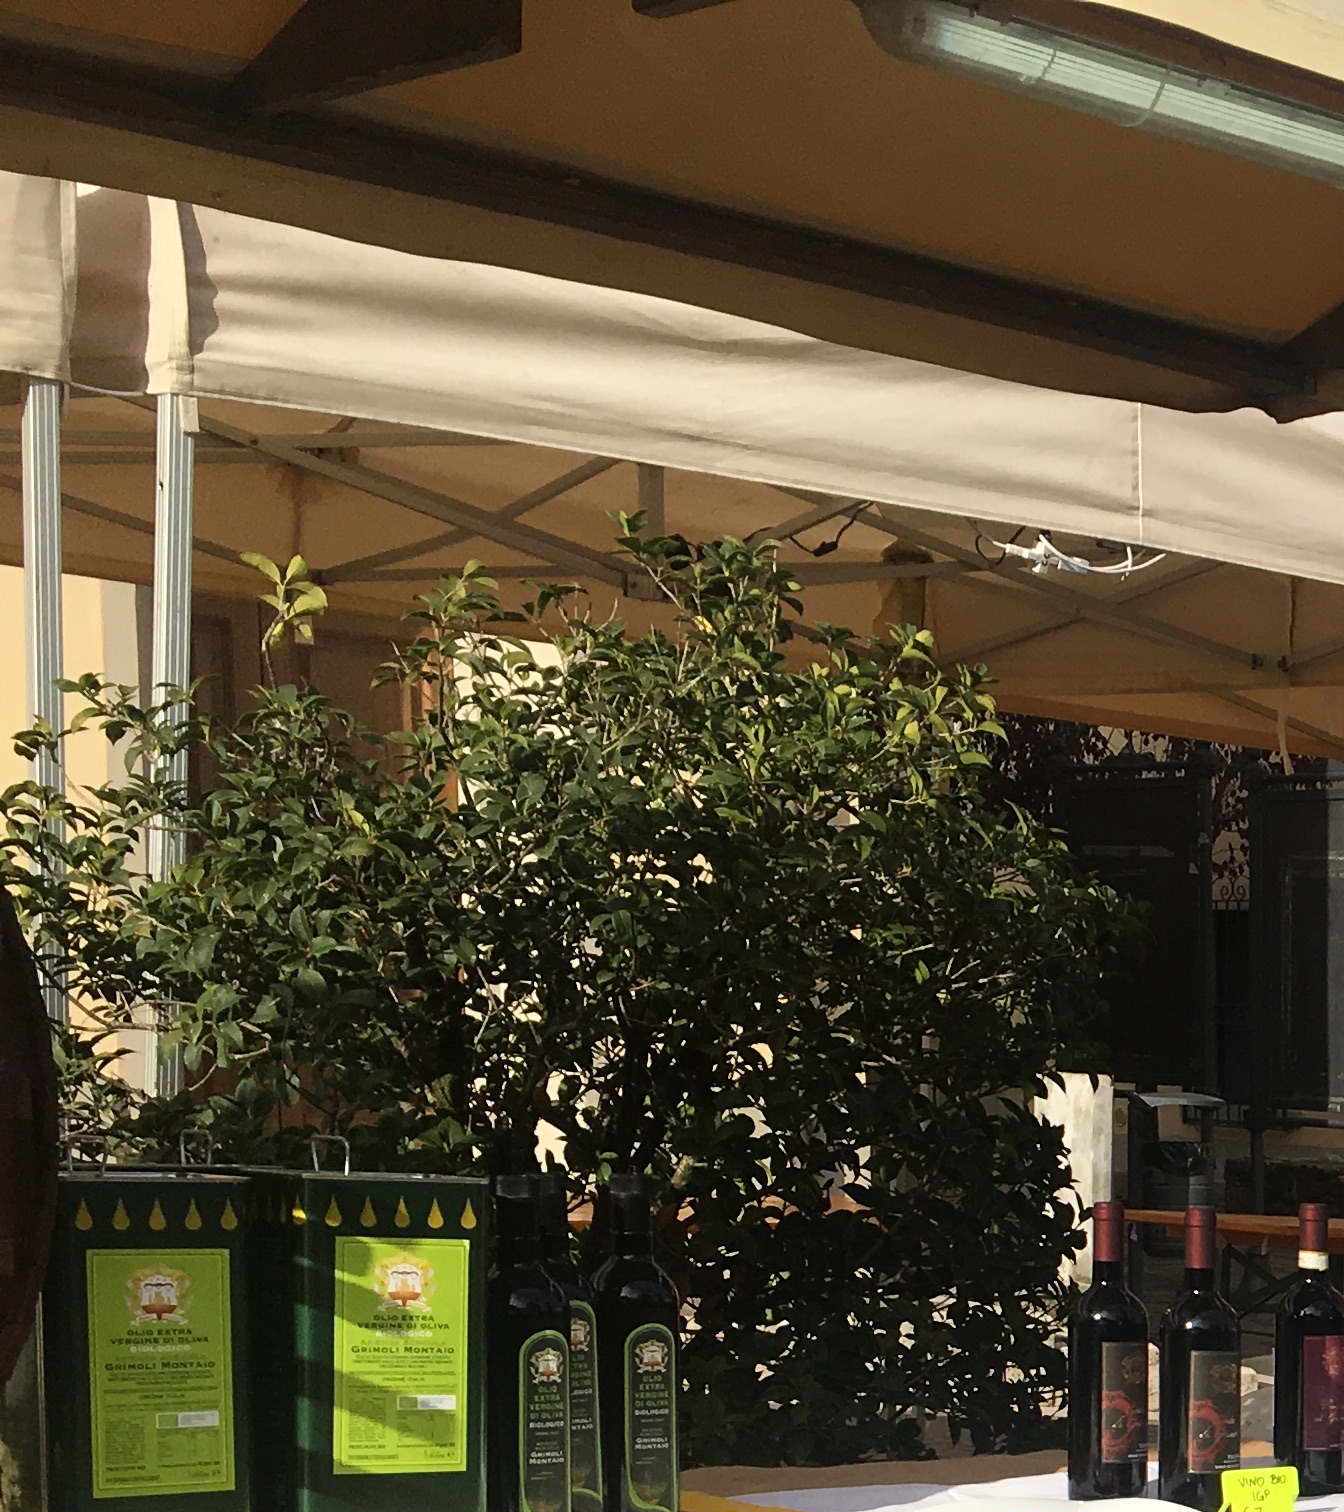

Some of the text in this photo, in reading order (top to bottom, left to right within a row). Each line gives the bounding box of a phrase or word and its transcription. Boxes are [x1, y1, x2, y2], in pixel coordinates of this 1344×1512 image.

[401, 1313, 435, 1322] EXTRA
[357, 1322, 402, 1330] VERGINE
[420, 1322, 450, 1330] OLIVA
[127, 1327, 193, 1336] OLIO EXTRA
[110, 1336, 160, 1345] VERGINE
[177, 1336, 209, 1344] OLIVA
[350, 1345, 455, 1354] GRIMOLI MONTAIO
[104, 1360, 216, 1371] GRIMOLI MONTAIO
[1238, 1473, 1287, 1487] VINO BIO
[1252, 1489, 1271, 1502] IGP
